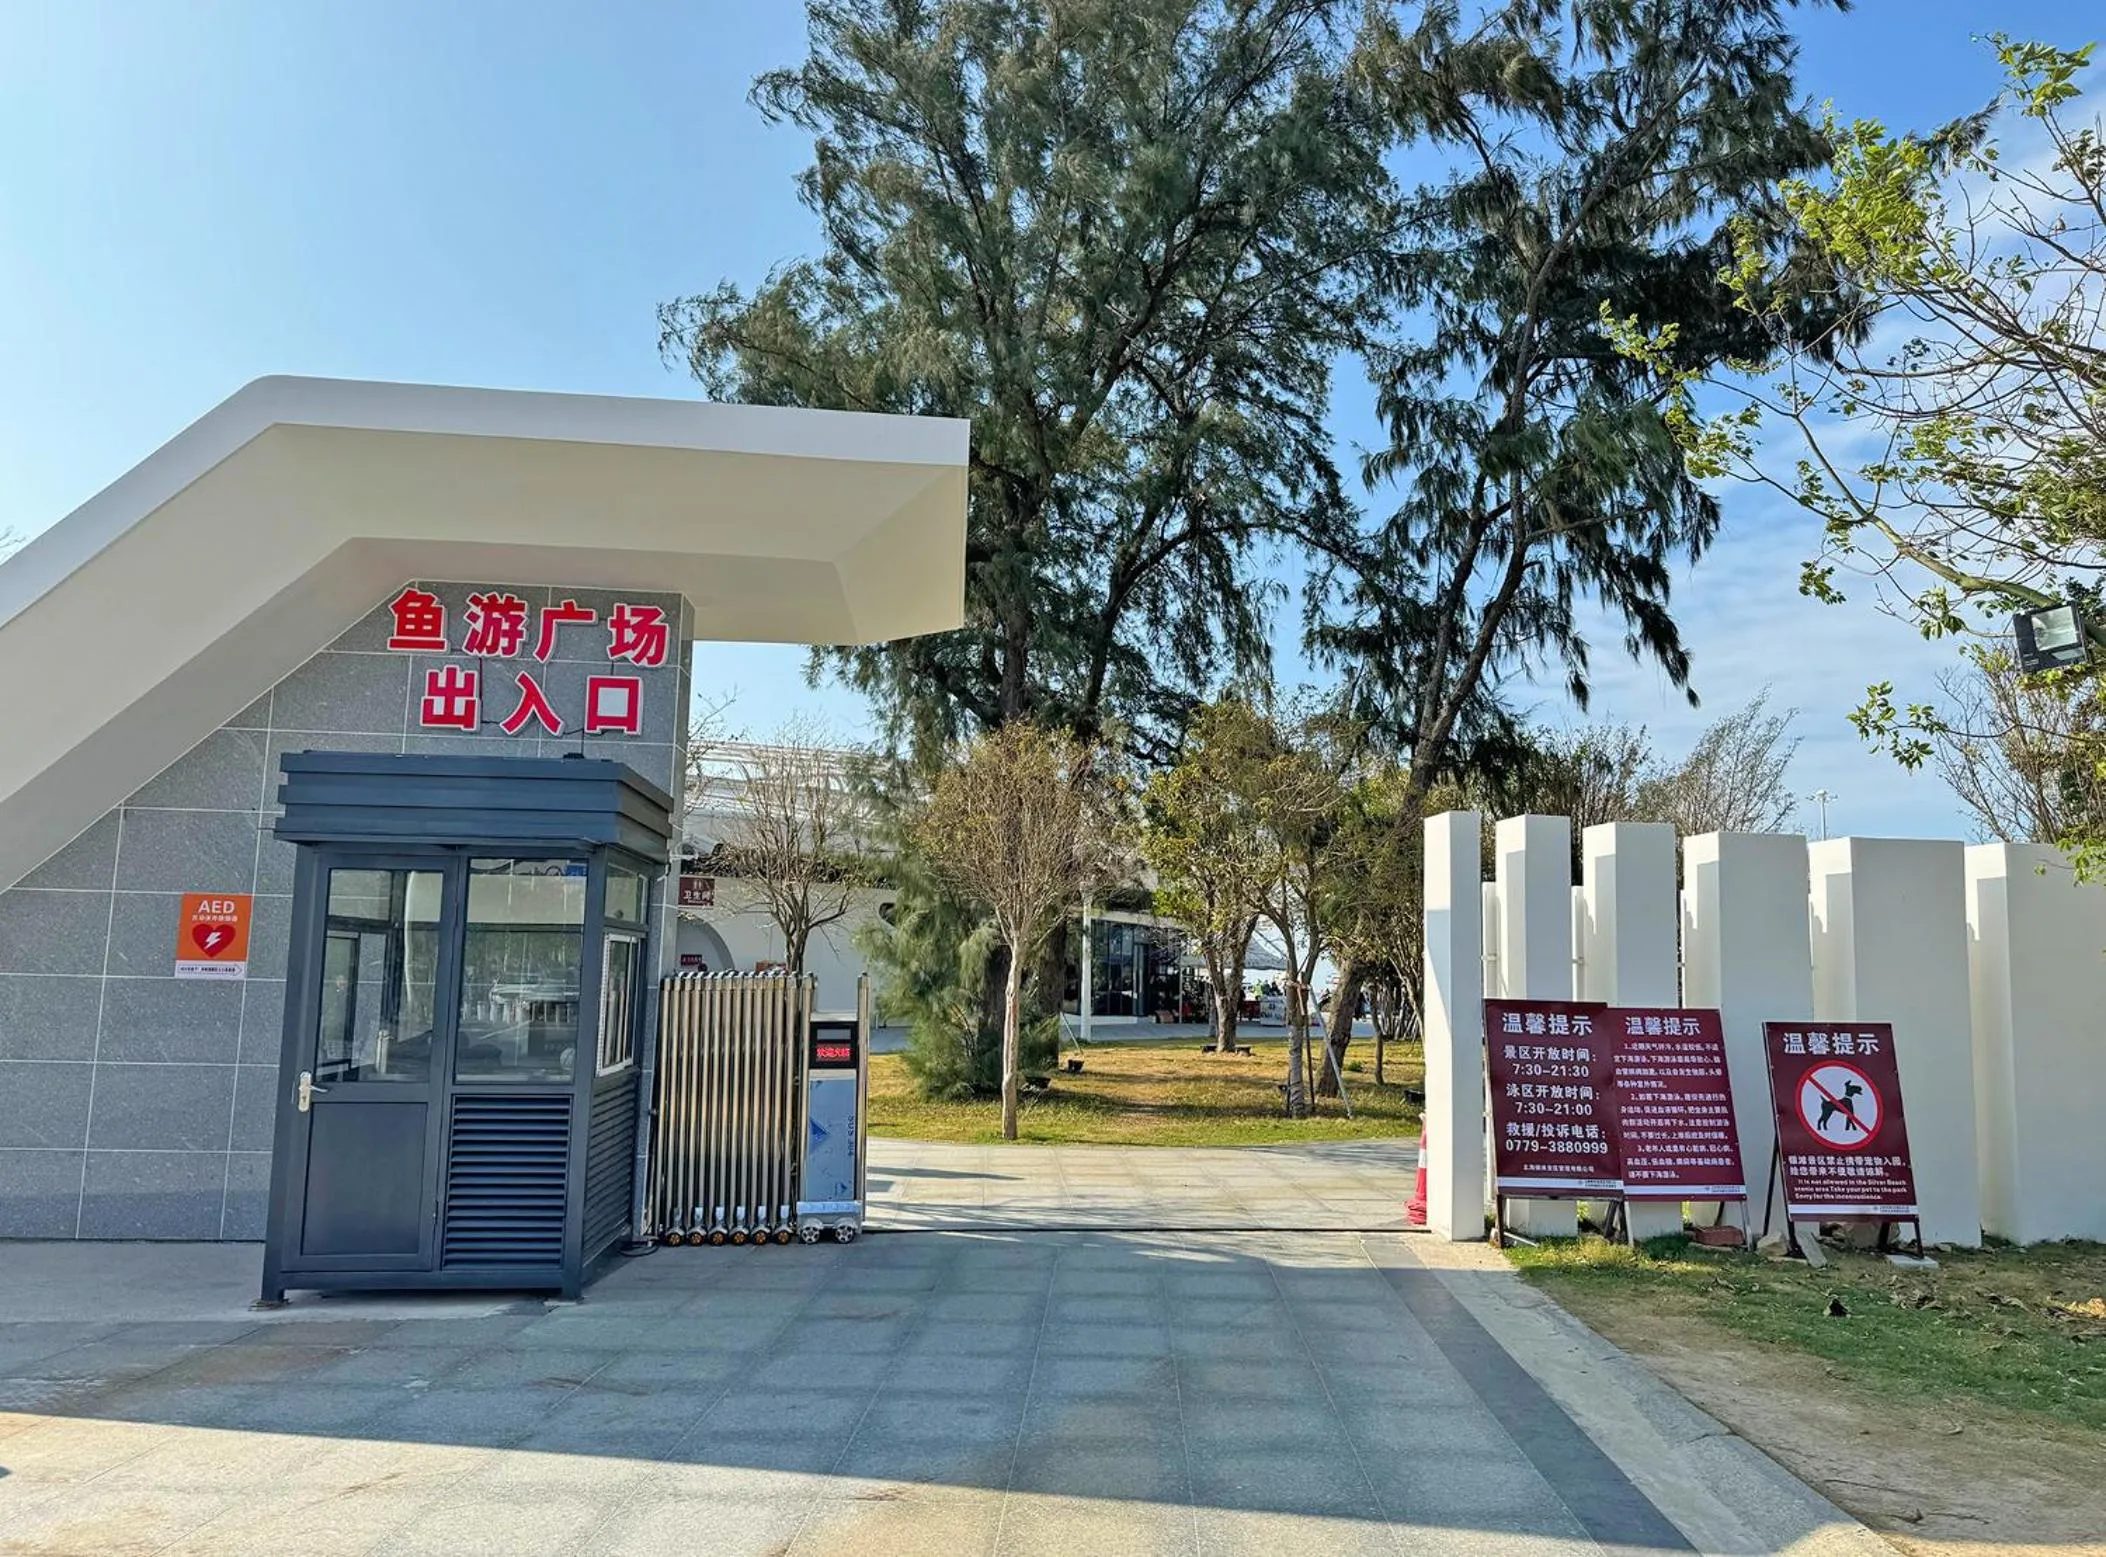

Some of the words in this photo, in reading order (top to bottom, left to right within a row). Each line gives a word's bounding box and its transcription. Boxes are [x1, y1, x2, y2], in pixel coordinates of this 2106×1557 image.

[387, 588, 670, 667] 鱼游广场
[420, 665, 642, 736] 出入口
[198, 899, 235, 914] AED
[1502, 1012, 1593, 1036] 温馨提示
[1625, 1016, 1701, 1036] 温馨提示
[1783, 1031, 1880, 1055] 温馨提示
[1512, 1063, 1589, 1078] 7:30-21:30
[1515, 1102, 1593, 1116] 7:30-21:00
[1505, 1139, 1609, 1154] 0779-3880999
